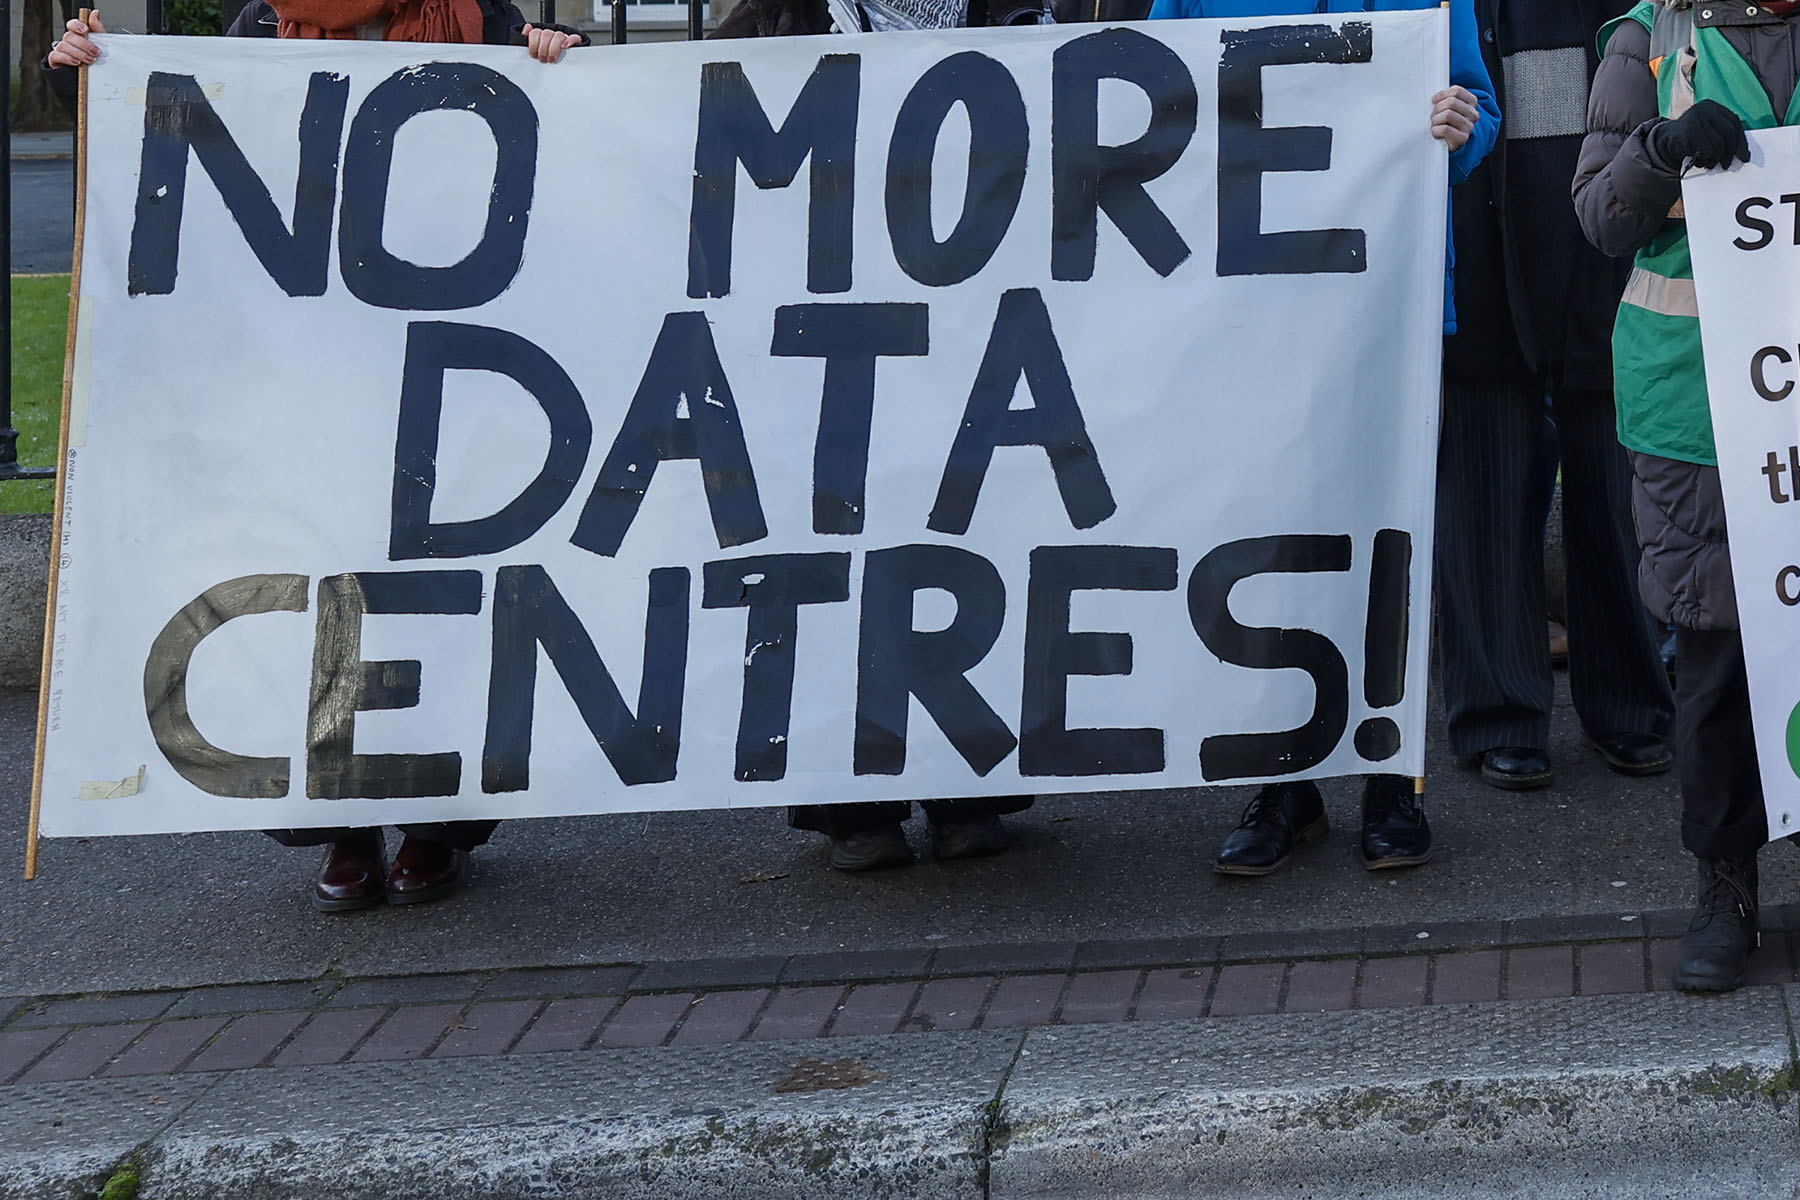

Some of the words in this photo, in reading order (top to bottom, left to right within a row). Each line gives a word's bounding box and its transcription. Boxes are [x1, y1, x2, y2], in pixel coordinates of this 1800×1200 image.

[128, 61, 539, 311] NO
[686, 21, 1373, 299] MORE
[64, 485, 73, 527] VIOLENT
[68, 459, 76, 481] NON
[388, 287, 1118, 561] DATA
[144, 529, 1413, 799] CENTRES!
